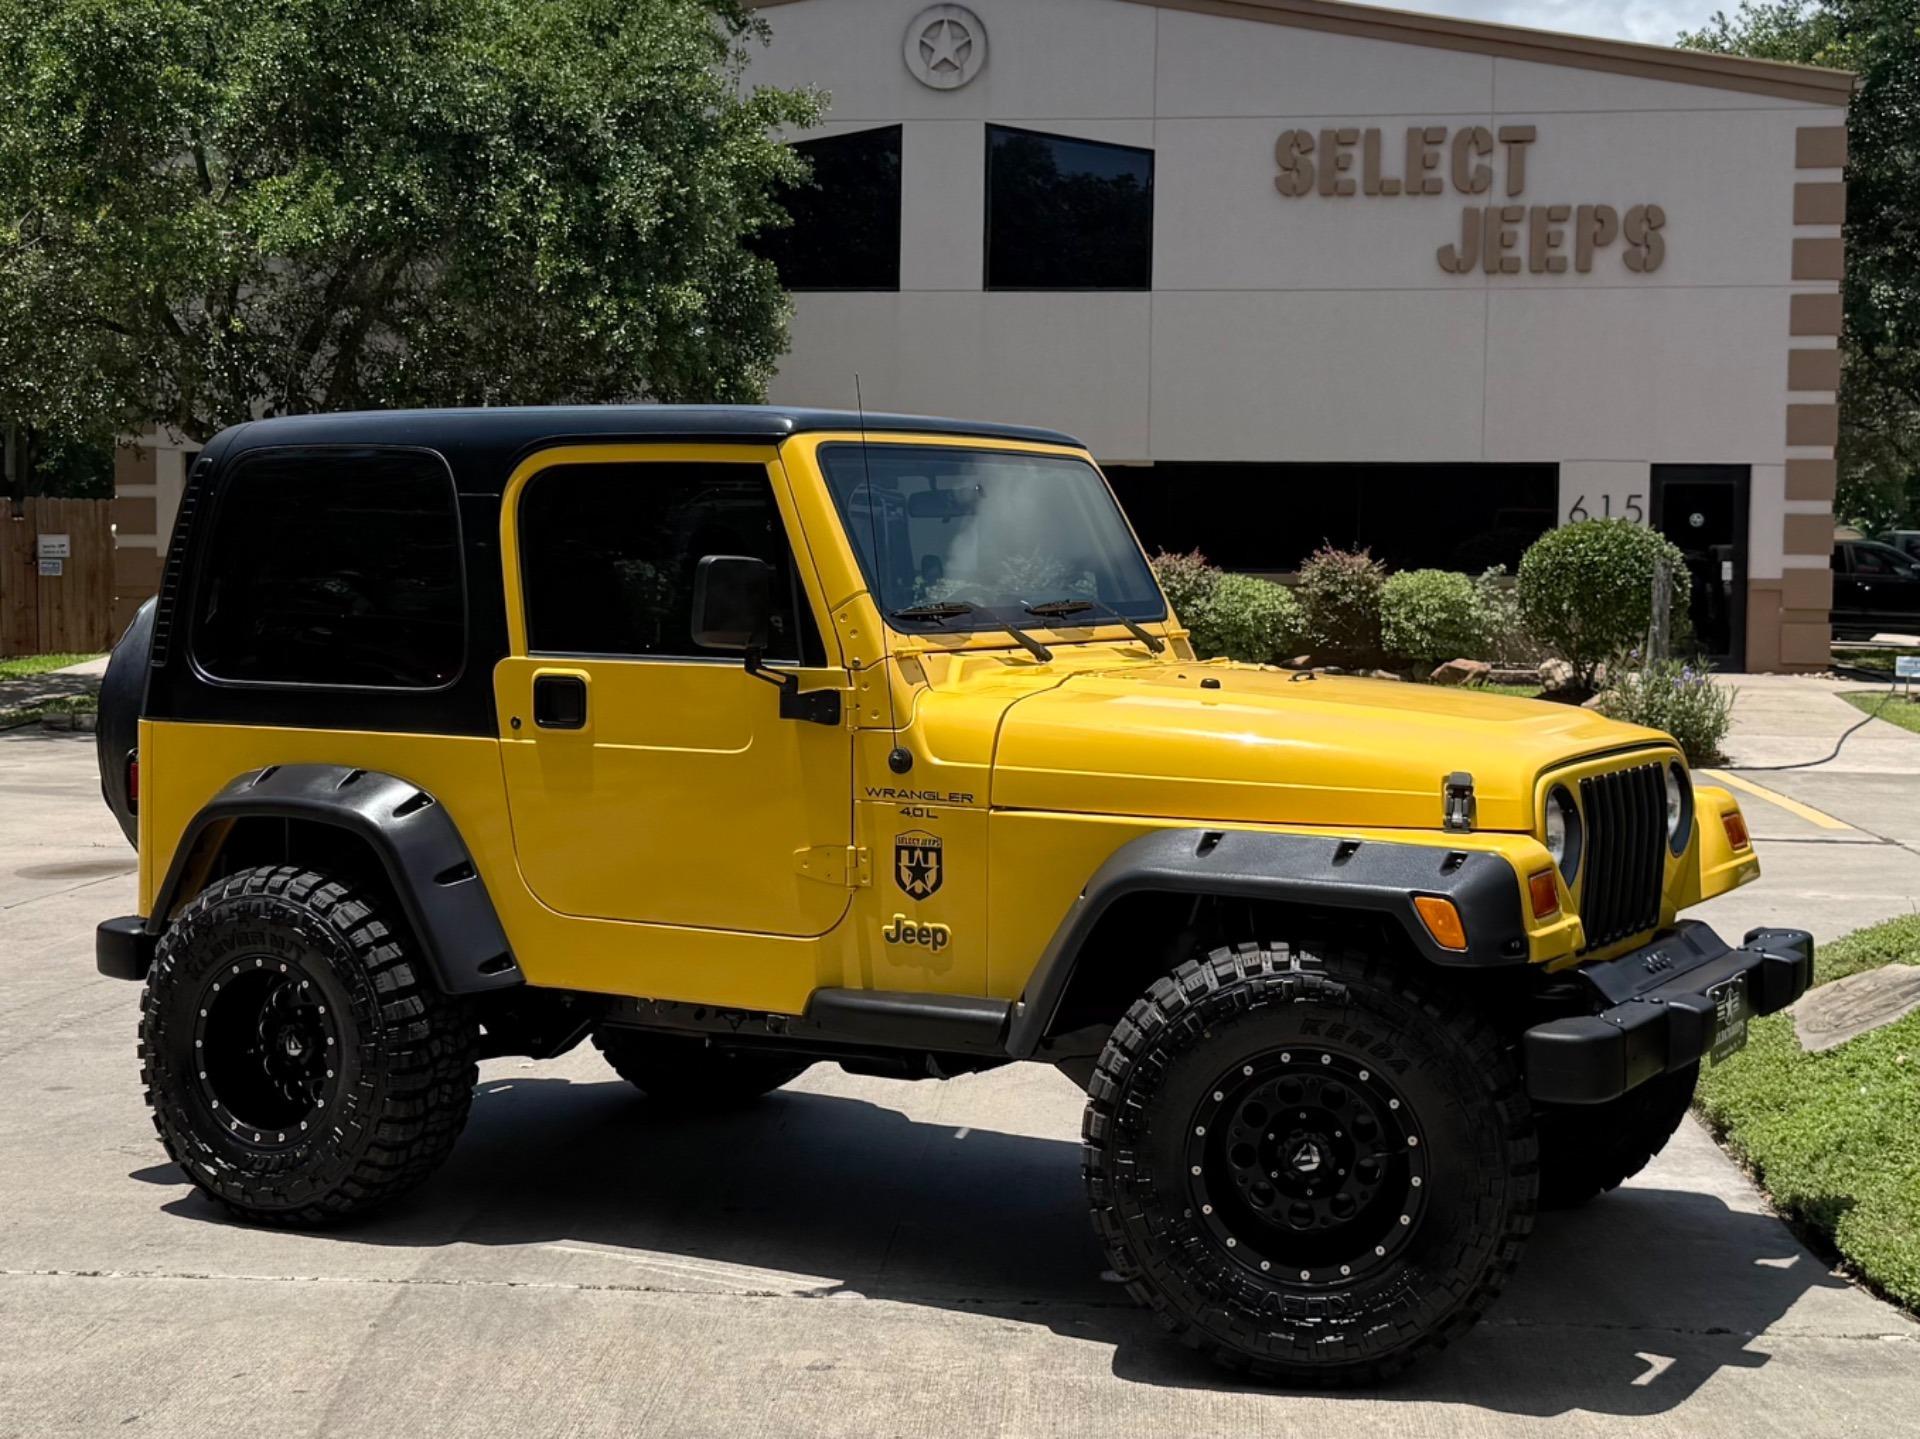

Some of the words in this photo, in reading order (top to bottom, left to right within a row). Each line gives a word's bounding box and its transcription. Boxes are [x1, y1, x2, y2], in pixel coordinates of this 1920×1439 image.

[1274, 125, 1536, 197] SELECT
[1436, 204, 1666, 274] JEEPS
[1569, 494, 1644, 524] 615
[865, 786, 974, 803] WRANGLER
[882, 913, 951, 951] Jeep
[1299, 1018, 1410, 1074] KENDA
